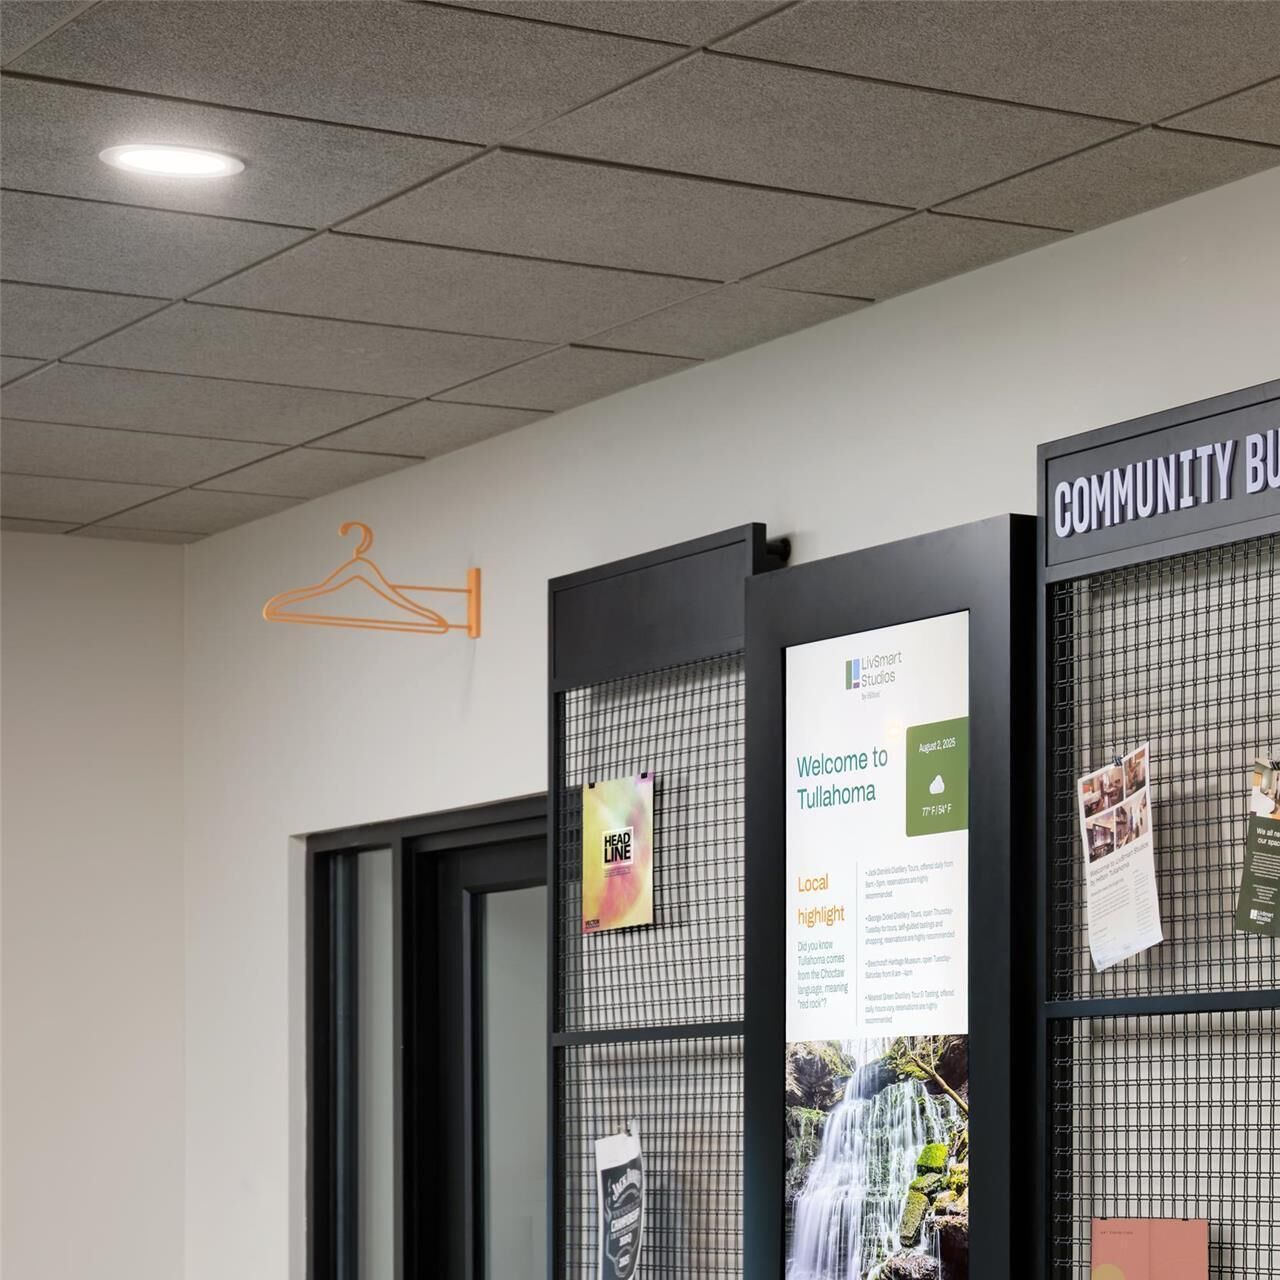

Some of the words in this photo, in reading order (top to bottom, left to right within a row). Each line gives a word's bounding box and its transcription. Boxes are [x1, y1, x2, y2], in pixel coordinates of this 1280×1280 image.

[1055, 440, 1238, 538] COMMUNITY
[862, 652, 902, 670] LivSmart
[862, 670, 896, 688] Studios
[919, 739, 937, 754] August
[943, 737, 956, 750] 2025
[797, 752, 868, 778] Welcome
[872, 746, 888, 767] to
[797, 783, 876, 810] Tullahoma
[604, 832, 631, 848] HEAD
[1256, 827, 1266, 837] We
[1257, 838, 1267, 847] our
[604, 844, 631, 863] LINE
[798, 872, 828, 892] Local
[798, 905, 845, 928] highlight
[797, 941, 807, 952] Did
[807, 942, 818, 953] you
[819, 940, 833, 950] know
[798, 955, 825, 966] Tullahoma
[826, 954, 845, 963] comes
